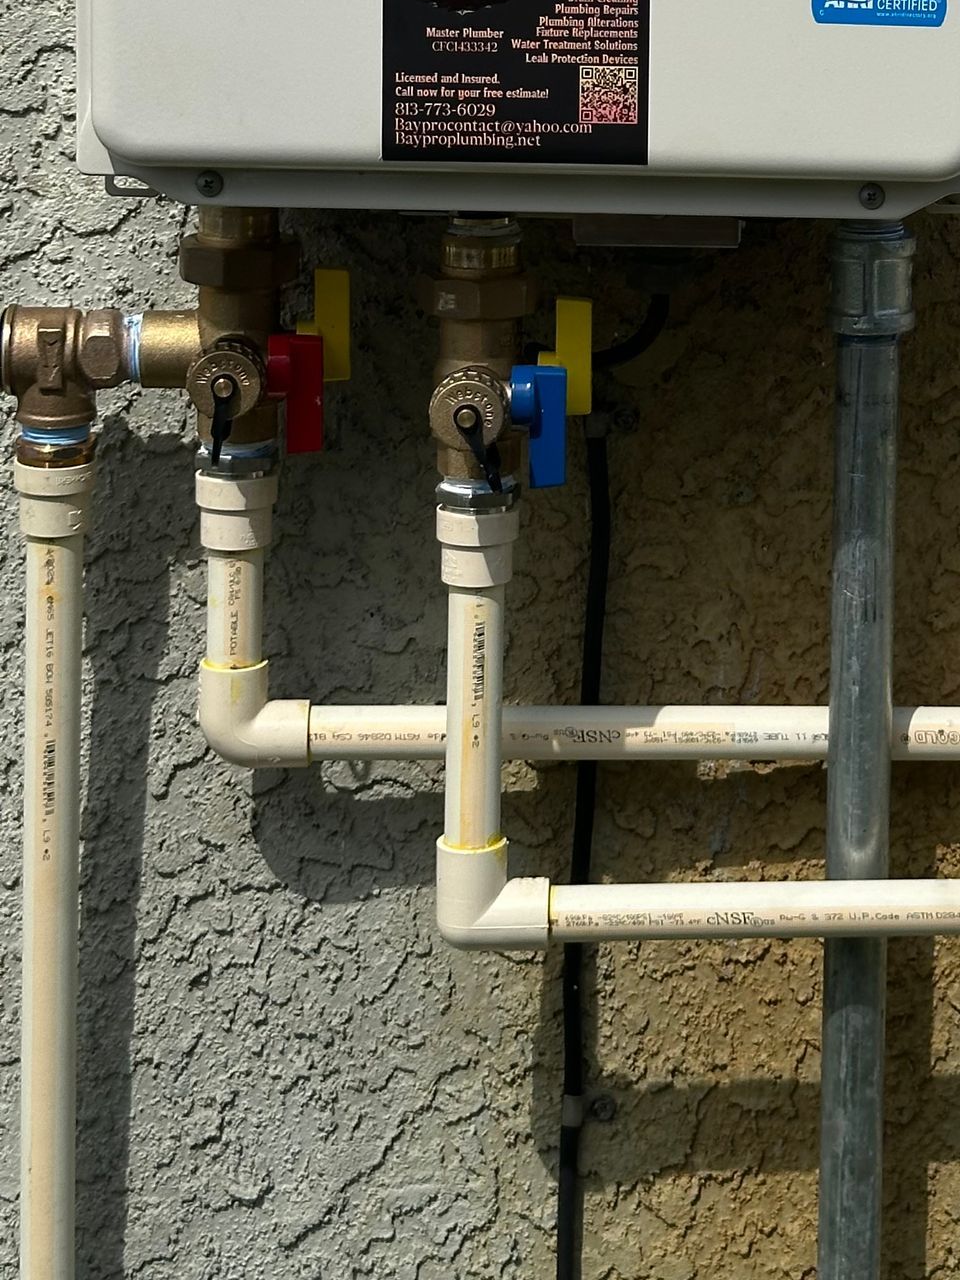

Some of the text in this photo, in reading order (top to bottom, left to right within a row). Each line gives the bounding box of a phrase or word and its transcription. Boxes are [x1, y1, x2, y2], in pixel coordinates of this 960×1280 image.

[555, 3, 639, 17] Plumbing Repairs
[539, 16, 639, 30] Plumbing Alterations
[426, 28, 504, 39] Master Plumber
[536, 27, 638, 40] Fixture Replacements
[511, 39, 638, 51] Water Treatment Solutions
[526, 53, 638, 65] Leak Protection Devices
[395, 73, 500, 84] Licensed and Insured.
[395, 86, 549, 100] Call now for your free estimate!
[395, 102, 496, 117] 813-773-6029
[395, 118, 592, 135] Bayprocontact@yahoo.com
[395, 131, 541, 149] Bayproplumbing.net
[195, 361, 250, 386] Webstone
[444, 389, 494, 428] Webstone
[230, 610, 239, 656] POTABLE
[331, 733, 352, 741] CSA
[393, 732, 421, 741] ASTM
[763, 732, 789, 741] TUBE
[914, 730, 960, 744] GOLD
[906, 911, 934, 920] ASTM
